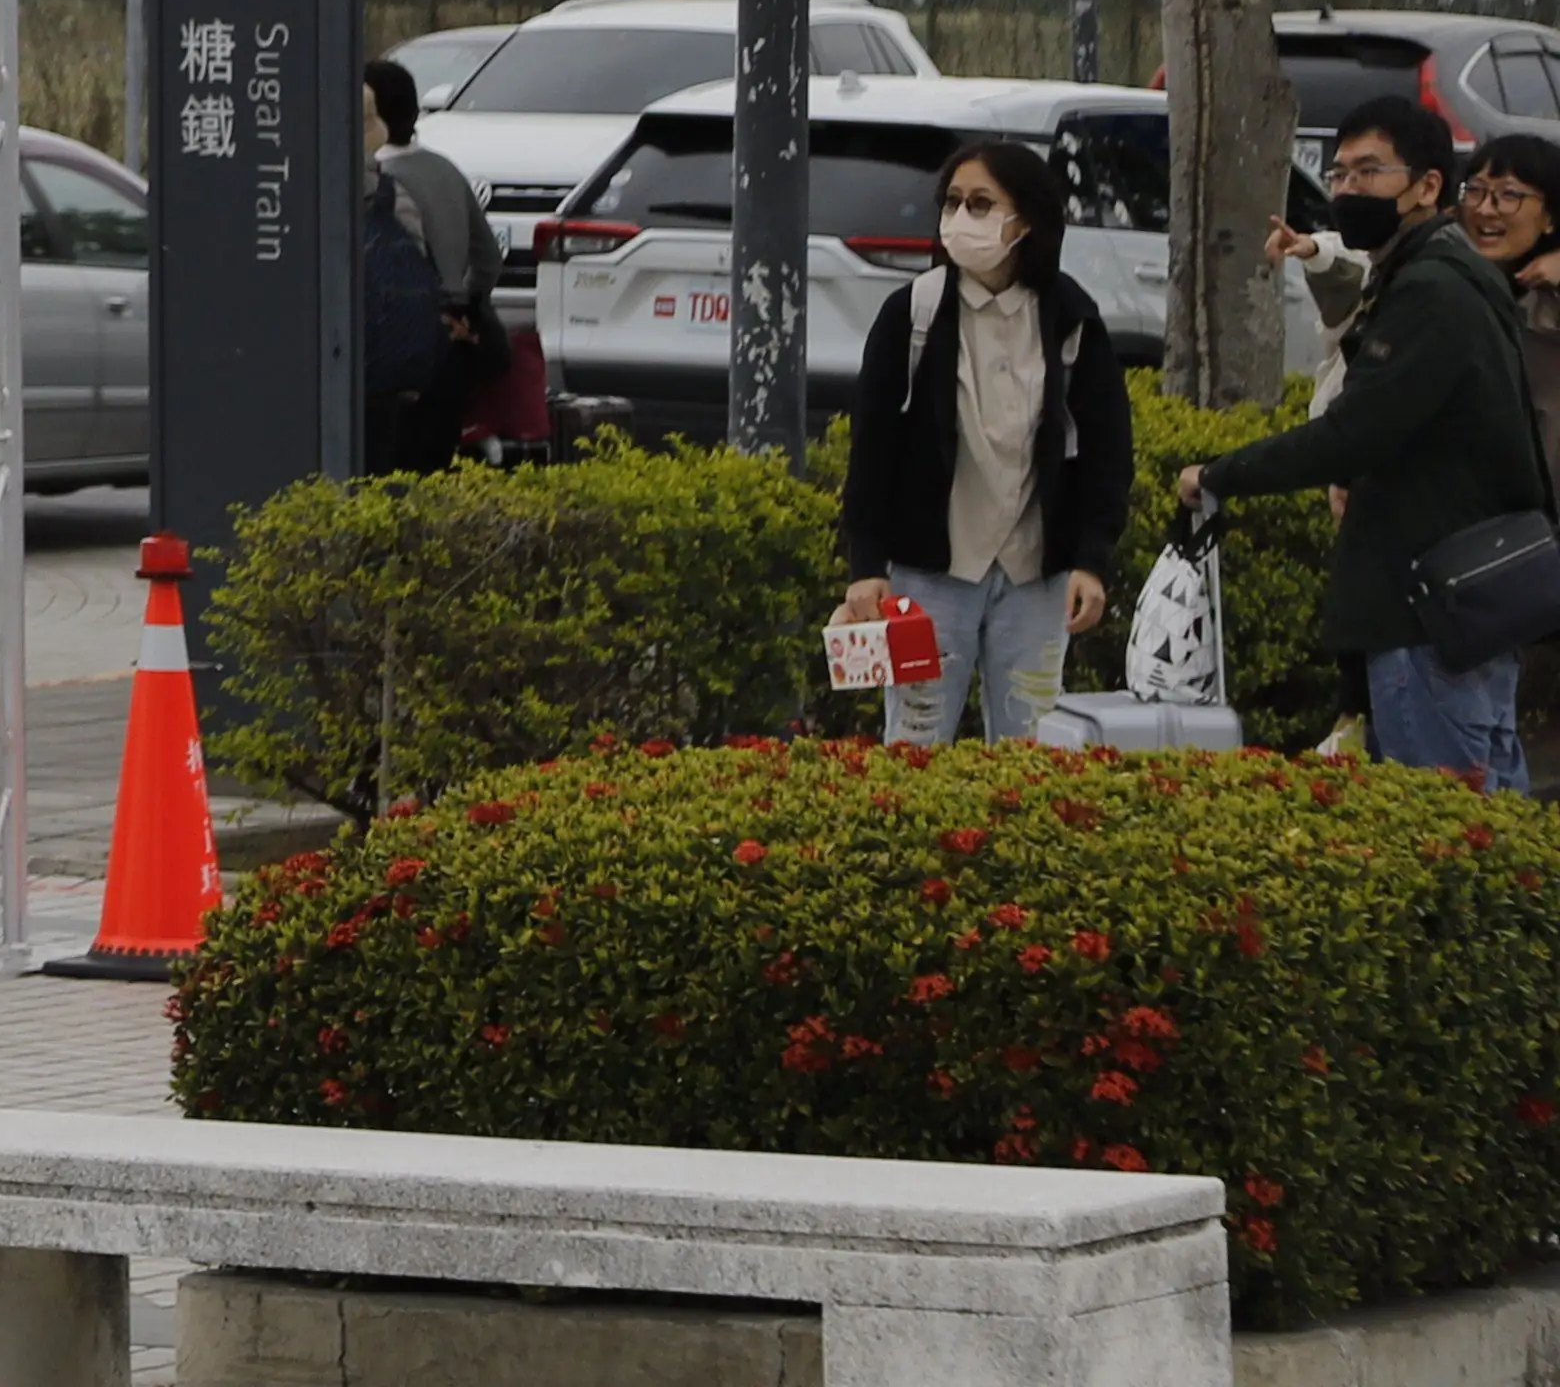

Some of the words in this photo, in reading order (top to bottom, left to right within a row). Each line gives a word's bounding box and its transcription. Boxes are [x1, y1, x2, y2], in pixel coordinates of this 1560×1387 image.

[179, 17, 236, 158] 糖鐵
[247, 23, 290, 147] Sugar
[256, 157, 291, 261] Train
